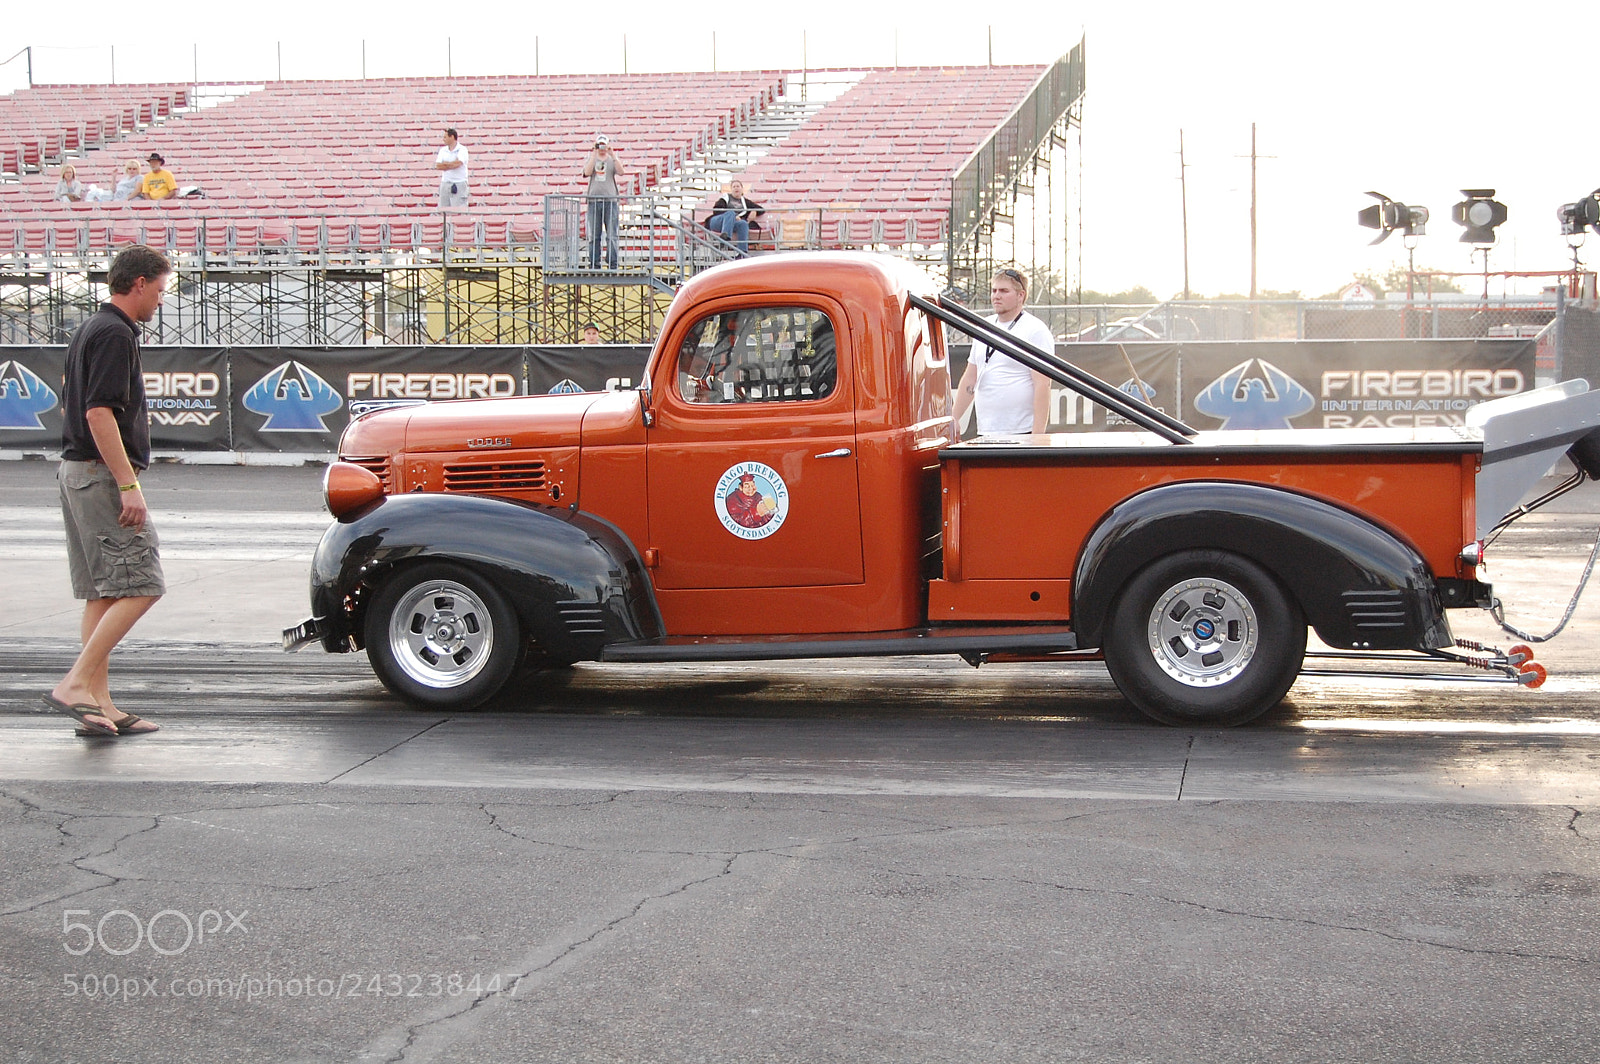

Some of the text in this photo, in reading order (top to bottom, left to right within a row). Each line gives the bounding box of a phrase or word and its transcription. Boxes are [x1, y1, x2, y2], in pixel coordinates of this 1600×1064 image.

[142, 372, 220, 397] BIRD
[347, 372, 516, 398] FIREBIRD
[1321, 369, 1524, 398] FIREBIRD
[1321, 399, 1486, 411] INTERNATIO
[1323, 415, 1465, 428] RACE
[467, 437, 512, 448] DODGE
[716, 463, 786, 500] PAPAGO BREWING
[773, 514, 783, 526] AZ
